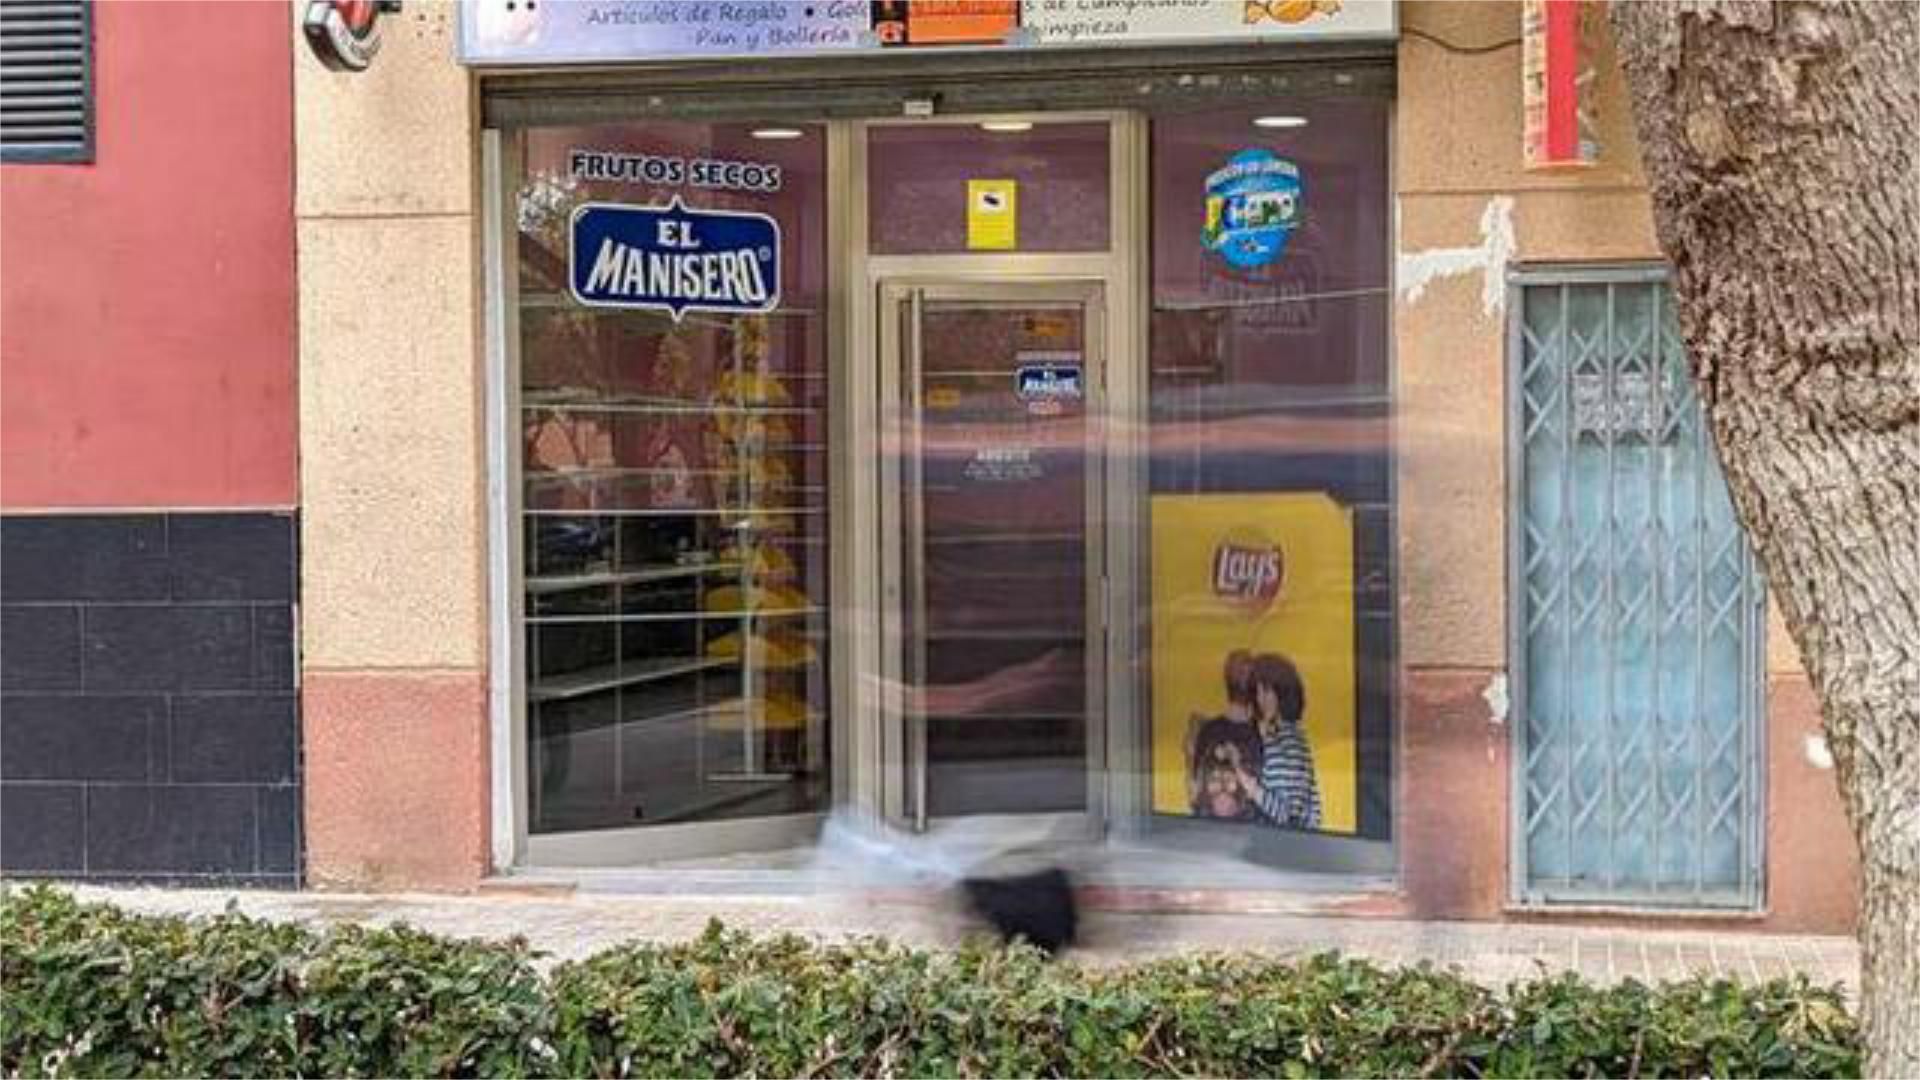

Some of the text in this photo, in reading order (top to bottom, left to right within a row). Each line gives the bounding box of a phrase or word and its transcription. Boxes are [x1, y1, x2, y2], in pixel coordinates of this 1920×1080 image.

[686, 2, 709, 22] de
[720, 1, 786, 27] Regalo
[696, 28, 736, 46] Pan
[746, 34, 759, 49] y
[571, 154, 780, 188] FRUTOS SECOS
[656, 220, 701, 248] EL
[583, 236, 767, 303] MANISERO
